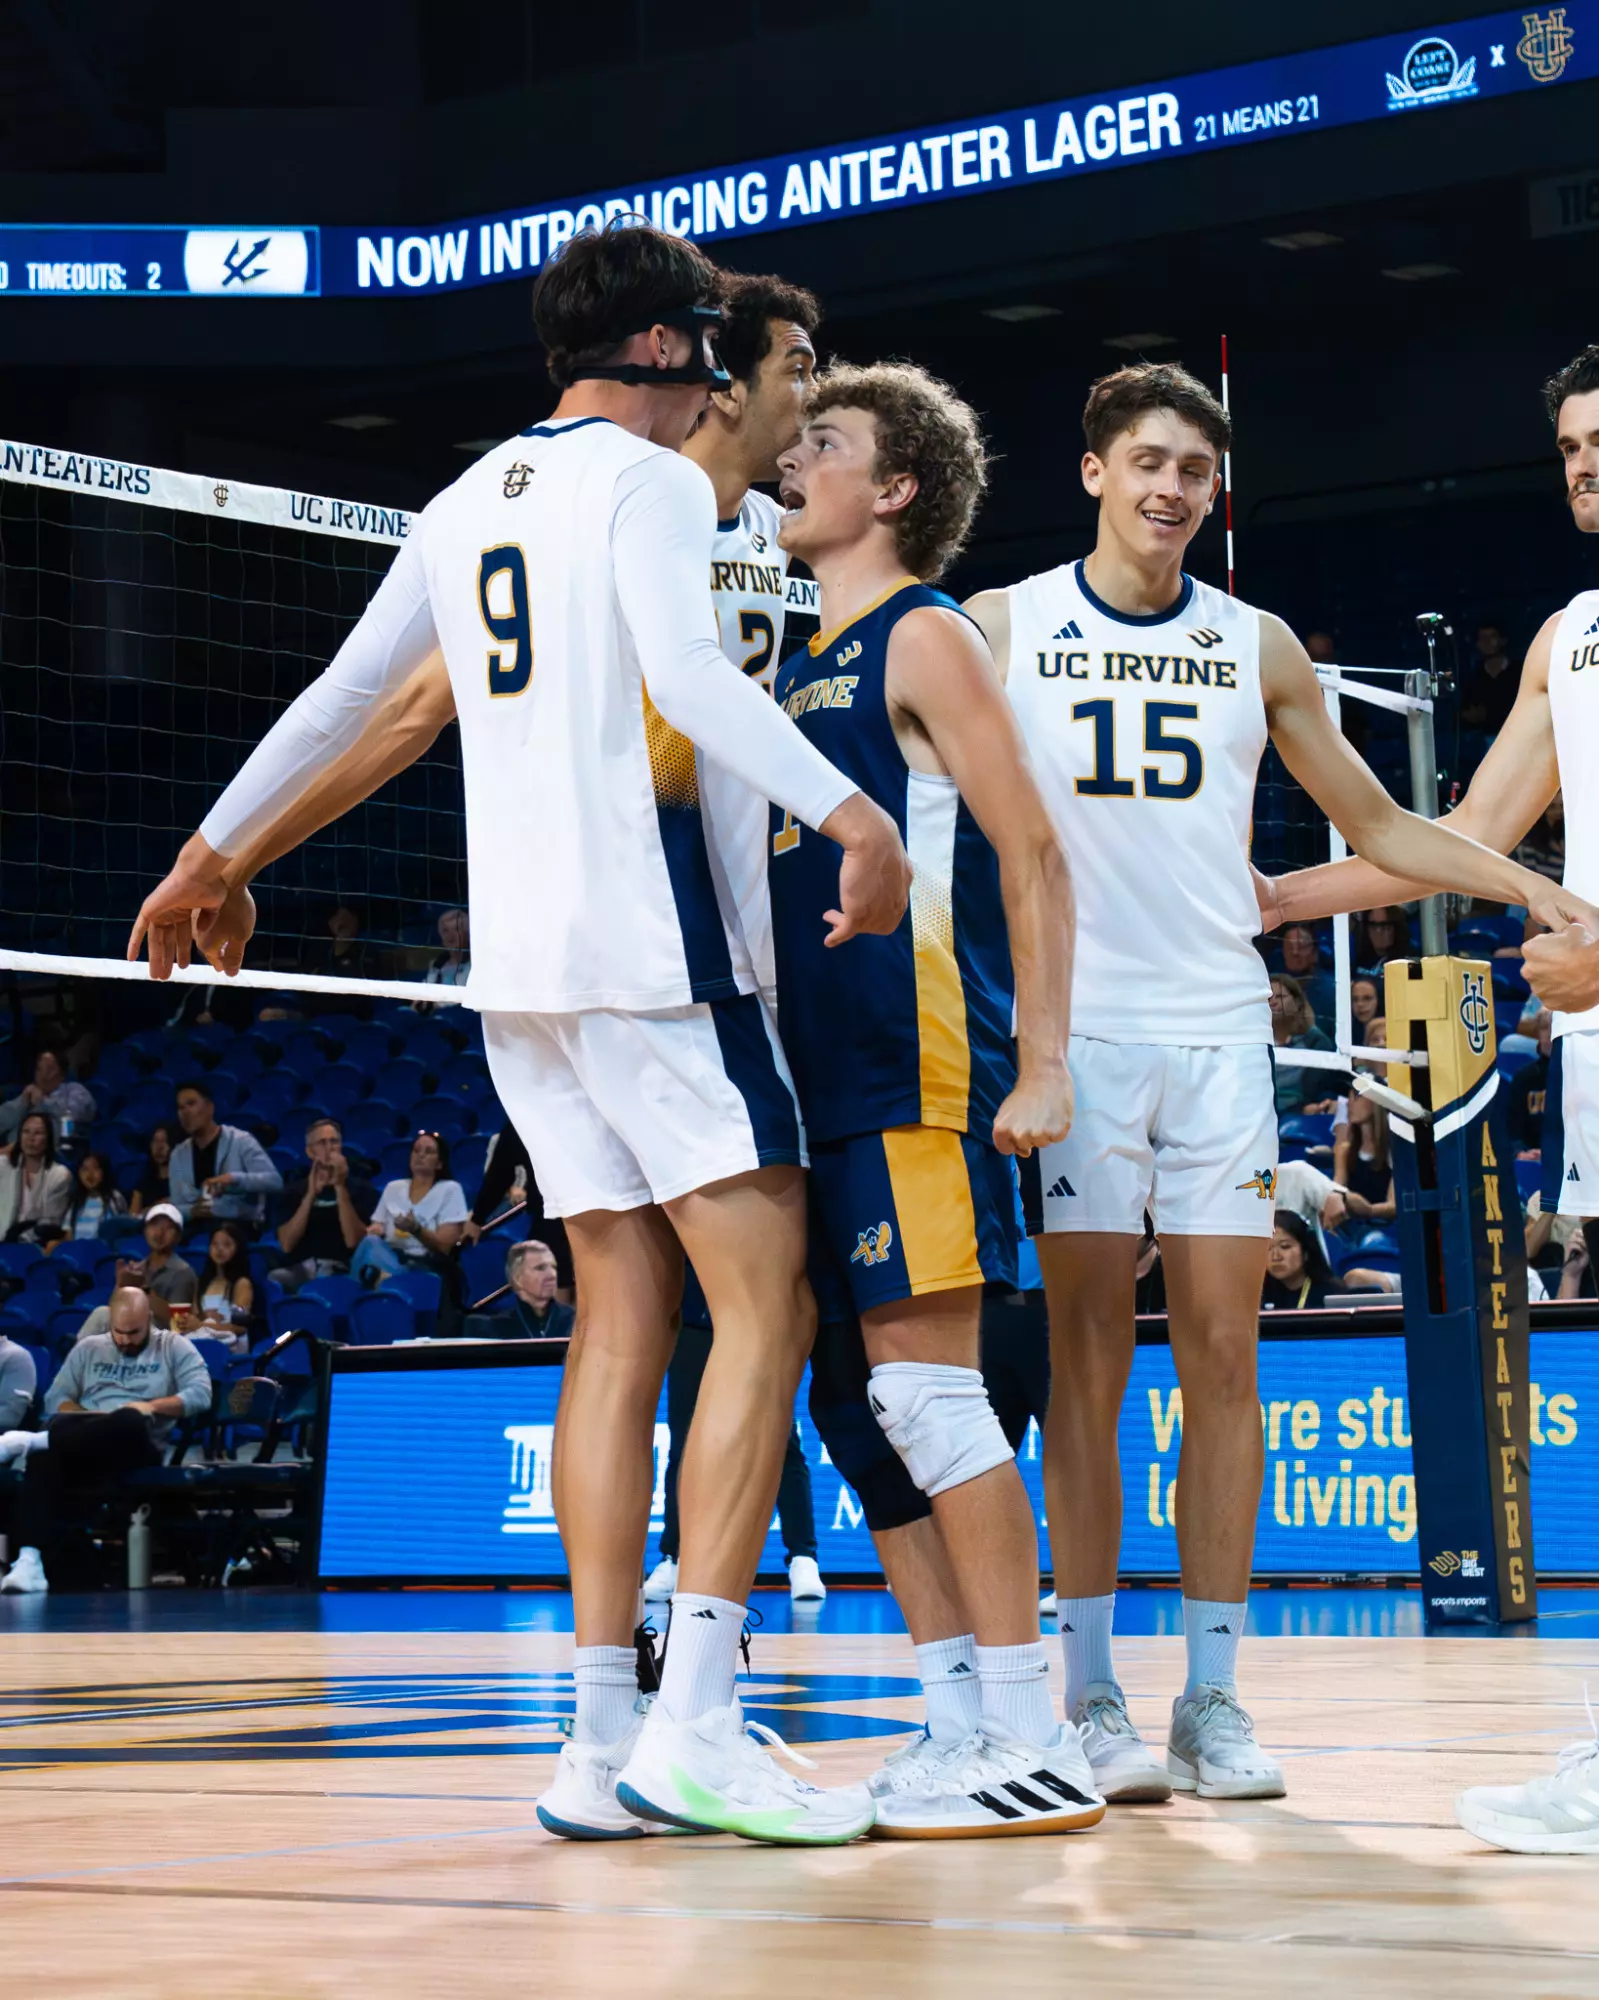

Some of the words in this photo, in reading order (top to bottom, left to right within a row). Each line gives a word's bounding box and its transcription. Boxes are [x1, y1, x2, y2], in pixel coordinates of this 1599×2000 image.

[1194, 114, 1217, 142] 21
[1222, 99, 1294, 136] MEANS
[1296, 94, 1319, 122] 21
[357, 229, 469, 288] NOW
[779, 125, 1013, 219] ANTEATER
[1024, 92, 1183, 174] LAGER
[26, 262, 127, 290] TIMEOUTS:
[147, 262, 161, 290] 2
[0, 443, 151, 495] NTEATERS
[291, 494, 324, 525] UC
[330, 501, 412, 538] IRVINE
[710, 560, 783, 596] RVINE
[785, 580, 819, 607] AN
[476, 542, 535, 698] 9
[1037, 652, 1089, 680] UC
[1103, 652, 1237, 689] IRVINE
[1070, 697, 1205, 802] 15
[1481, 1120, 1526, 1604] ANTEATERS
[1148, 1386, 1321, 1452] Wre
[1338, 1383, 1578, 1451] stuts
[1274, 1459, 1418, 1543] living
[1461, 1550, 1479, 1560] THE
[1461, 1559, 1478, 1568] BIG
[1461, 1567, 1485, 1577] WEST
